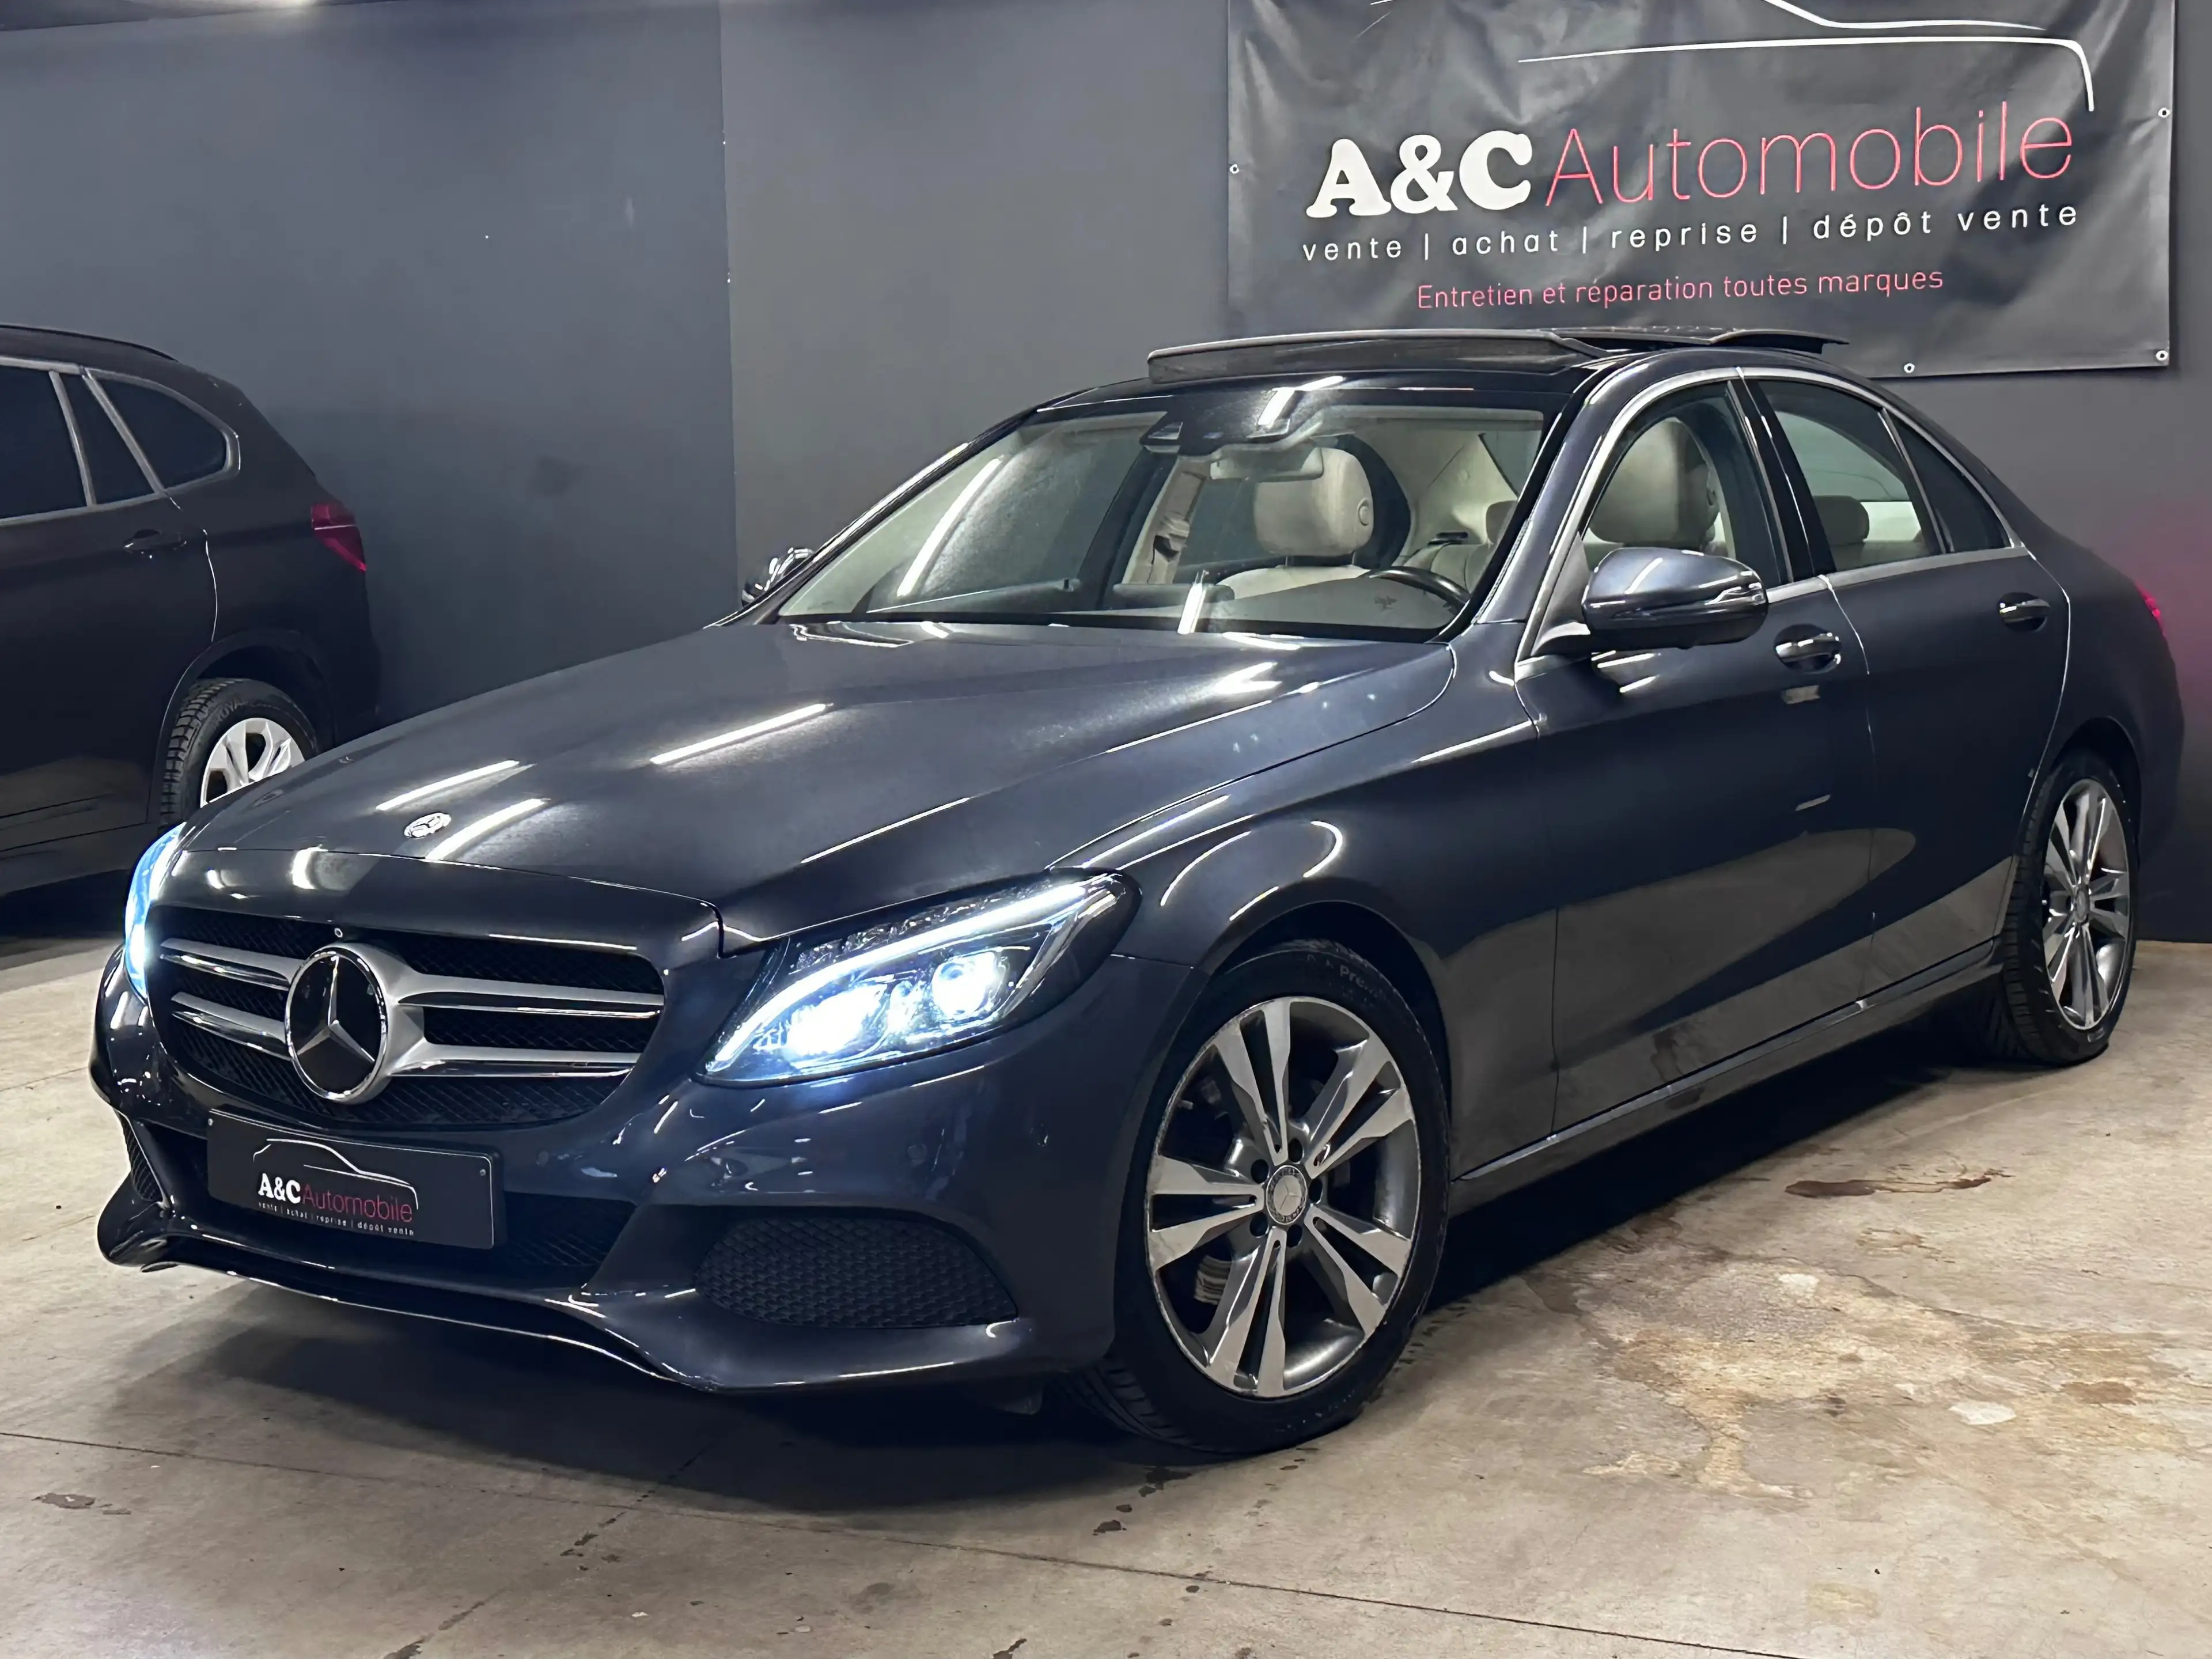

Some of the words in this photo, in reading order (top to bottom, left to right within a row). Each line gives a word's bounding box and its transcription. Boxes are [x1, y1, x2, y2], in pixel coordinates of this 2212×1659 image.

[1306, 130, 1533, 218] A&C
[1545, 101, 2074, 208] Automobile
[1302, 237, 1402, 262] vente
[1452, 230, 1559, 255] achat
[1611, 222, 1758, 252] reprise
[1813, 211, 1931, 242] dépôt
[1957, 204, 2077, 231] vente
[1417, 283, 1533, 309] Entretien
[1541, 284, 1566, 304] et
[1575, 276, 1714, 308] réparation
[1722, 275, 1808, 297] toutes
[1817, 271, 1944, 297] marques
[258, 1173, 301, 1203] A&C
[302, 1184, 413, 1222] Automobile
